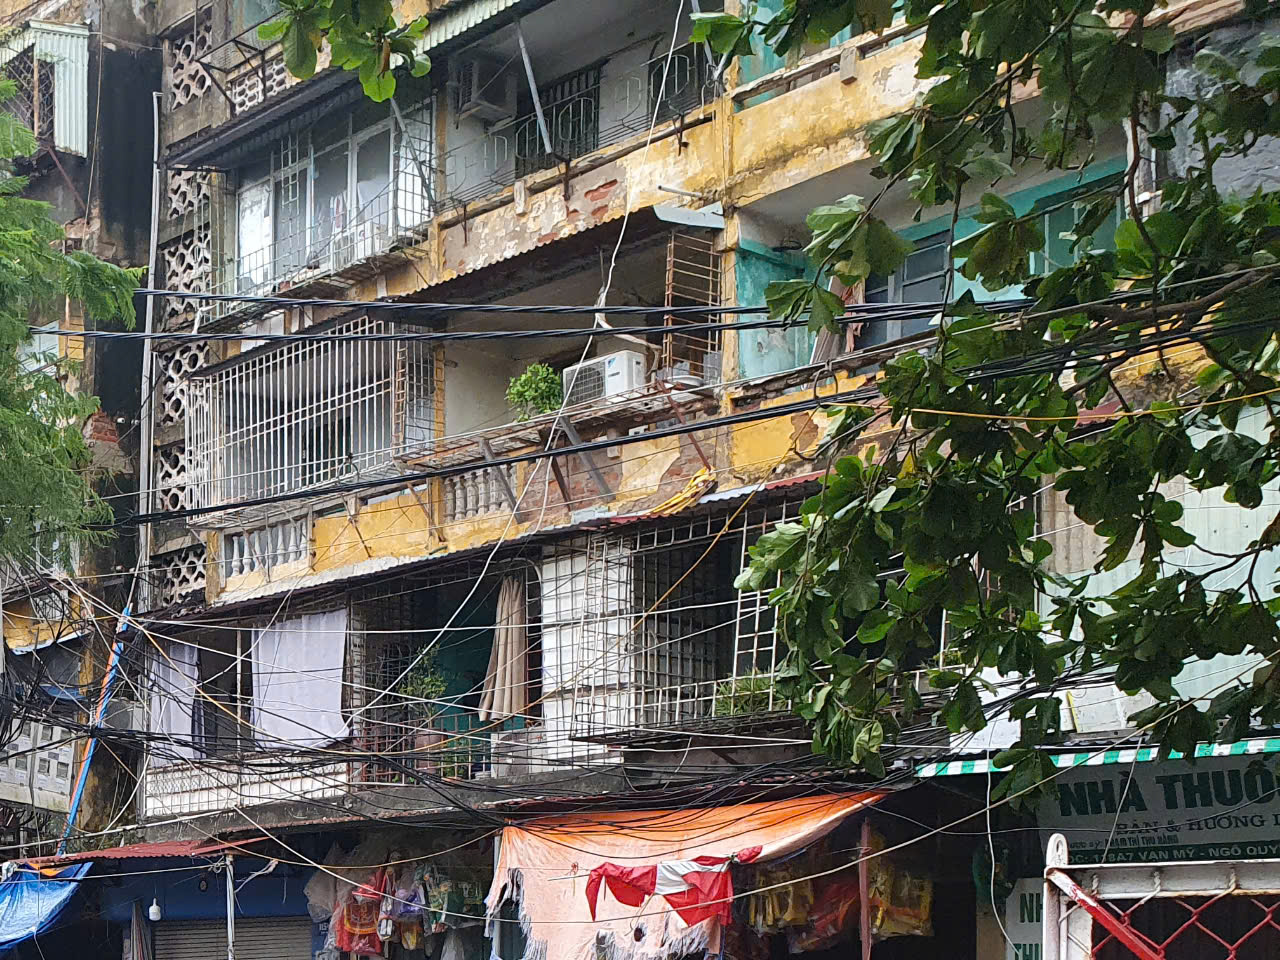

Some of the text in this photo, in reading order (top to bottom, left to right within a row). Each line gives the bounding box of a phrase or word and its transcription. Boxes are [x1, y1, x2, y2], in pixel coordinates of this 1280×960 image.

[1057, 755, 1280, 817] NHÀ THUỐ
[1209, 844, 1241, 857] NGÔ
[1020, 893, 1043, 923] NH
